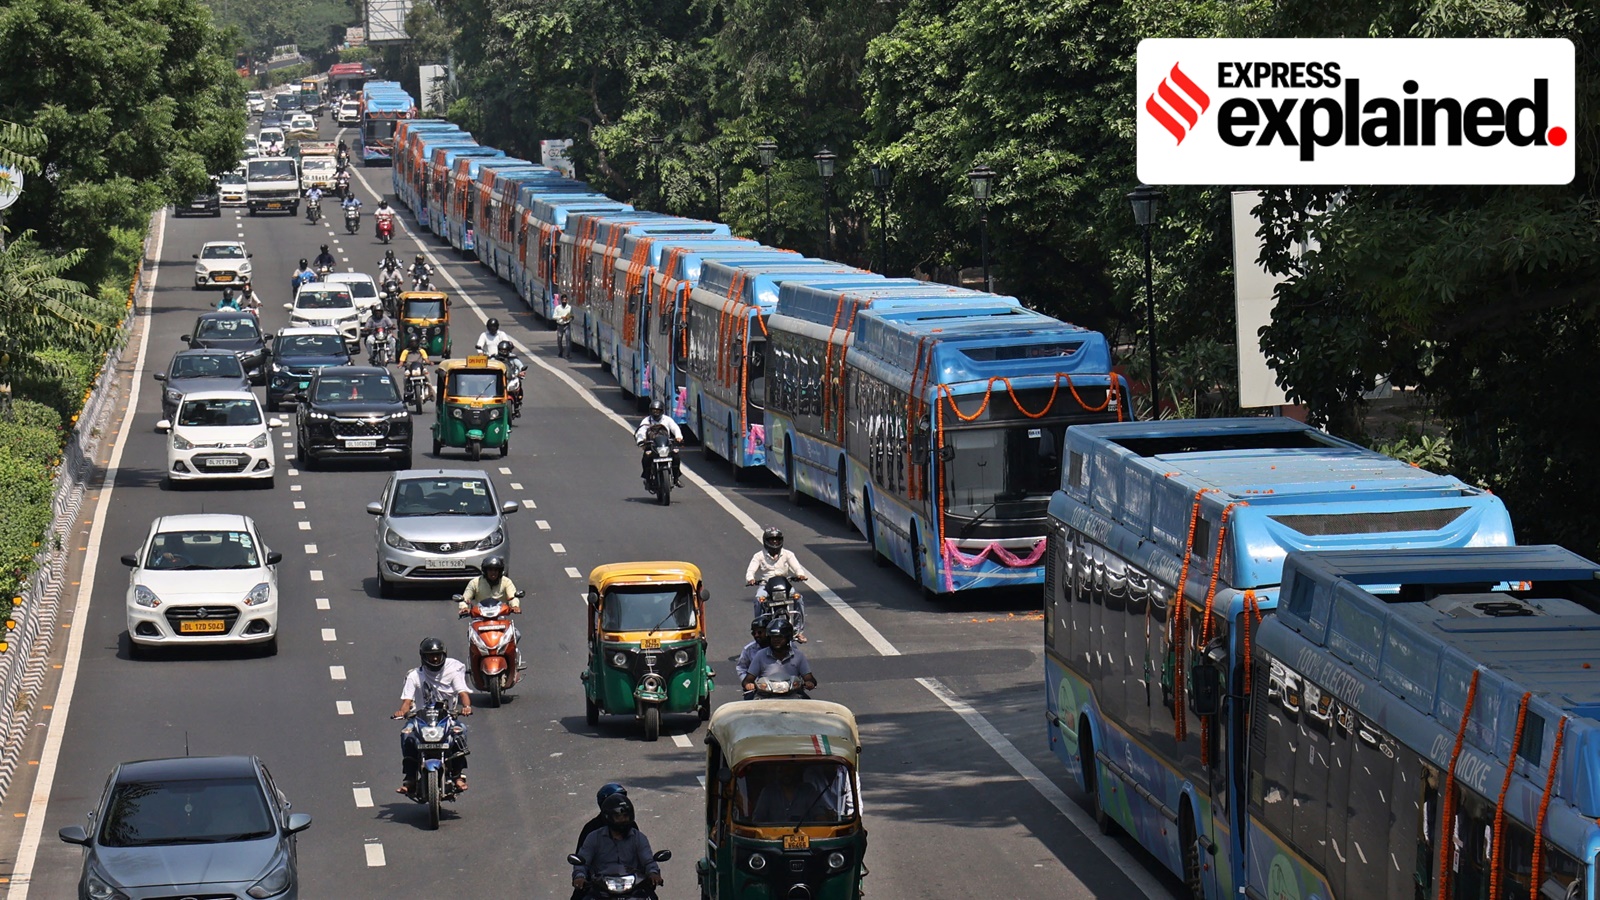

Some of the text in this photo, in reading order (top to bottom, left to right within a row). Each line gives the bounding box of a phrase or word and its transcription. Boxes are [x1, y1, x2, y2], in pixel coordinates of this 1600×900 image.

[208, 622, 224, 630] 5043
[1296, 646, 1324, 680] 100%
[1430, 733, 1491, 794] 0% MOKE.
